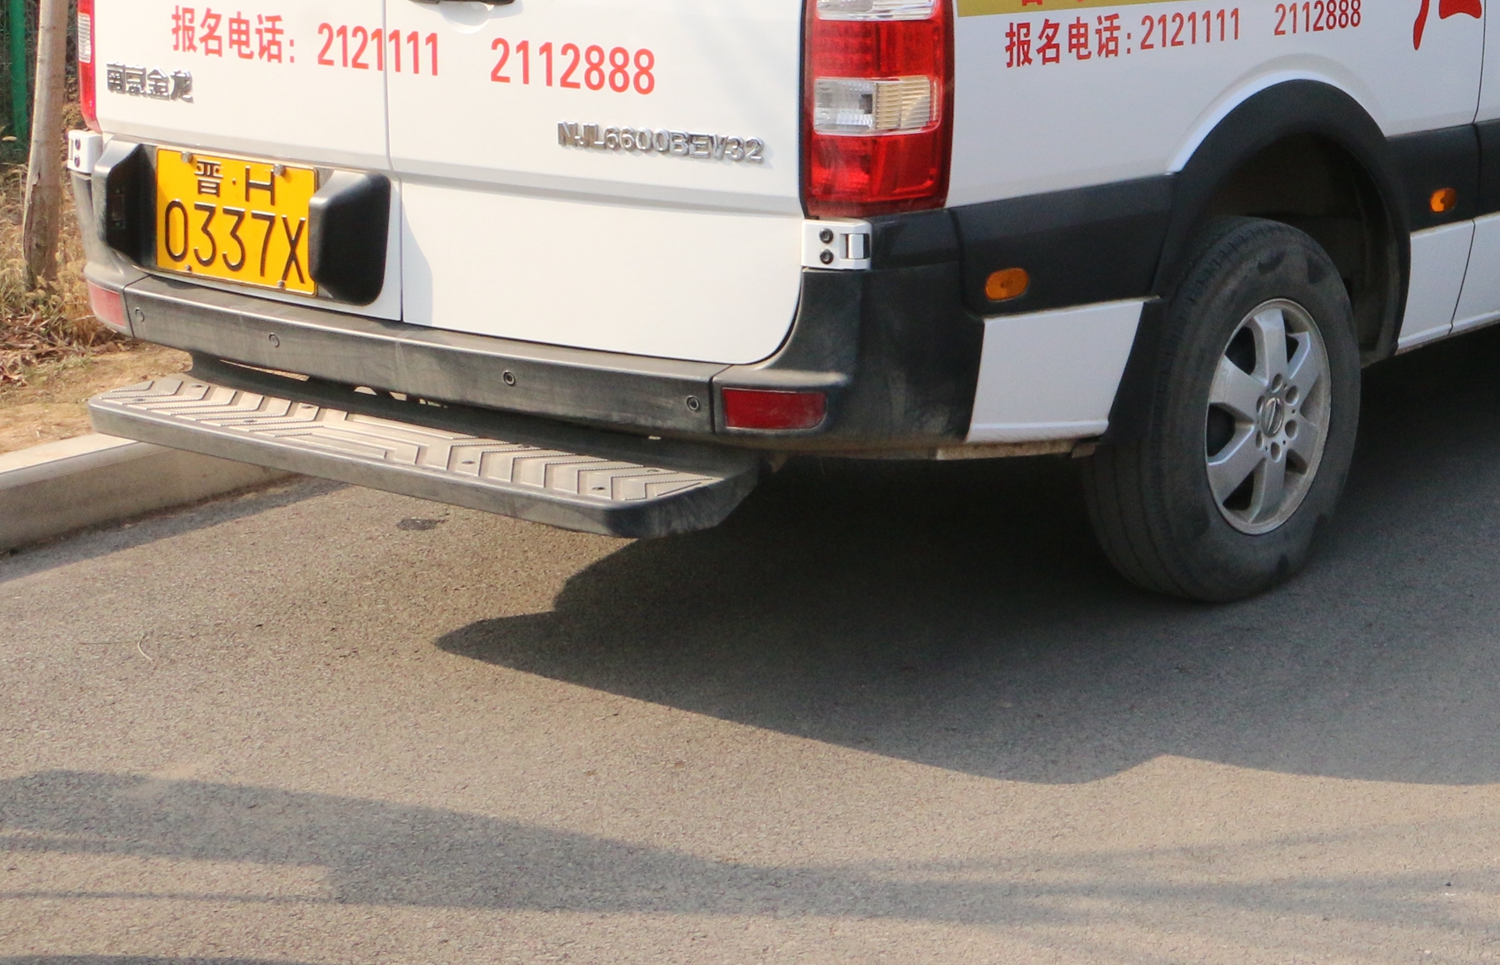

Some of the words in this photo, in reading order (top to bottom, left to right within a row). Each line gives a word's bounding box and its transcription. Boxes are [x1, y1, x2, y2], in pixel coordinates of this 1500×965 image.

[1140, 7, 1239, 50] 2121111
[317, 22, 439, 77] 2121111
[490, 37, 656, 95] 2112888
[106, 61, 194, 104] 南京金龙
[557, 121, 764, 164] NJL6600BEV32
[165, 199, 306, 284] 0337X
